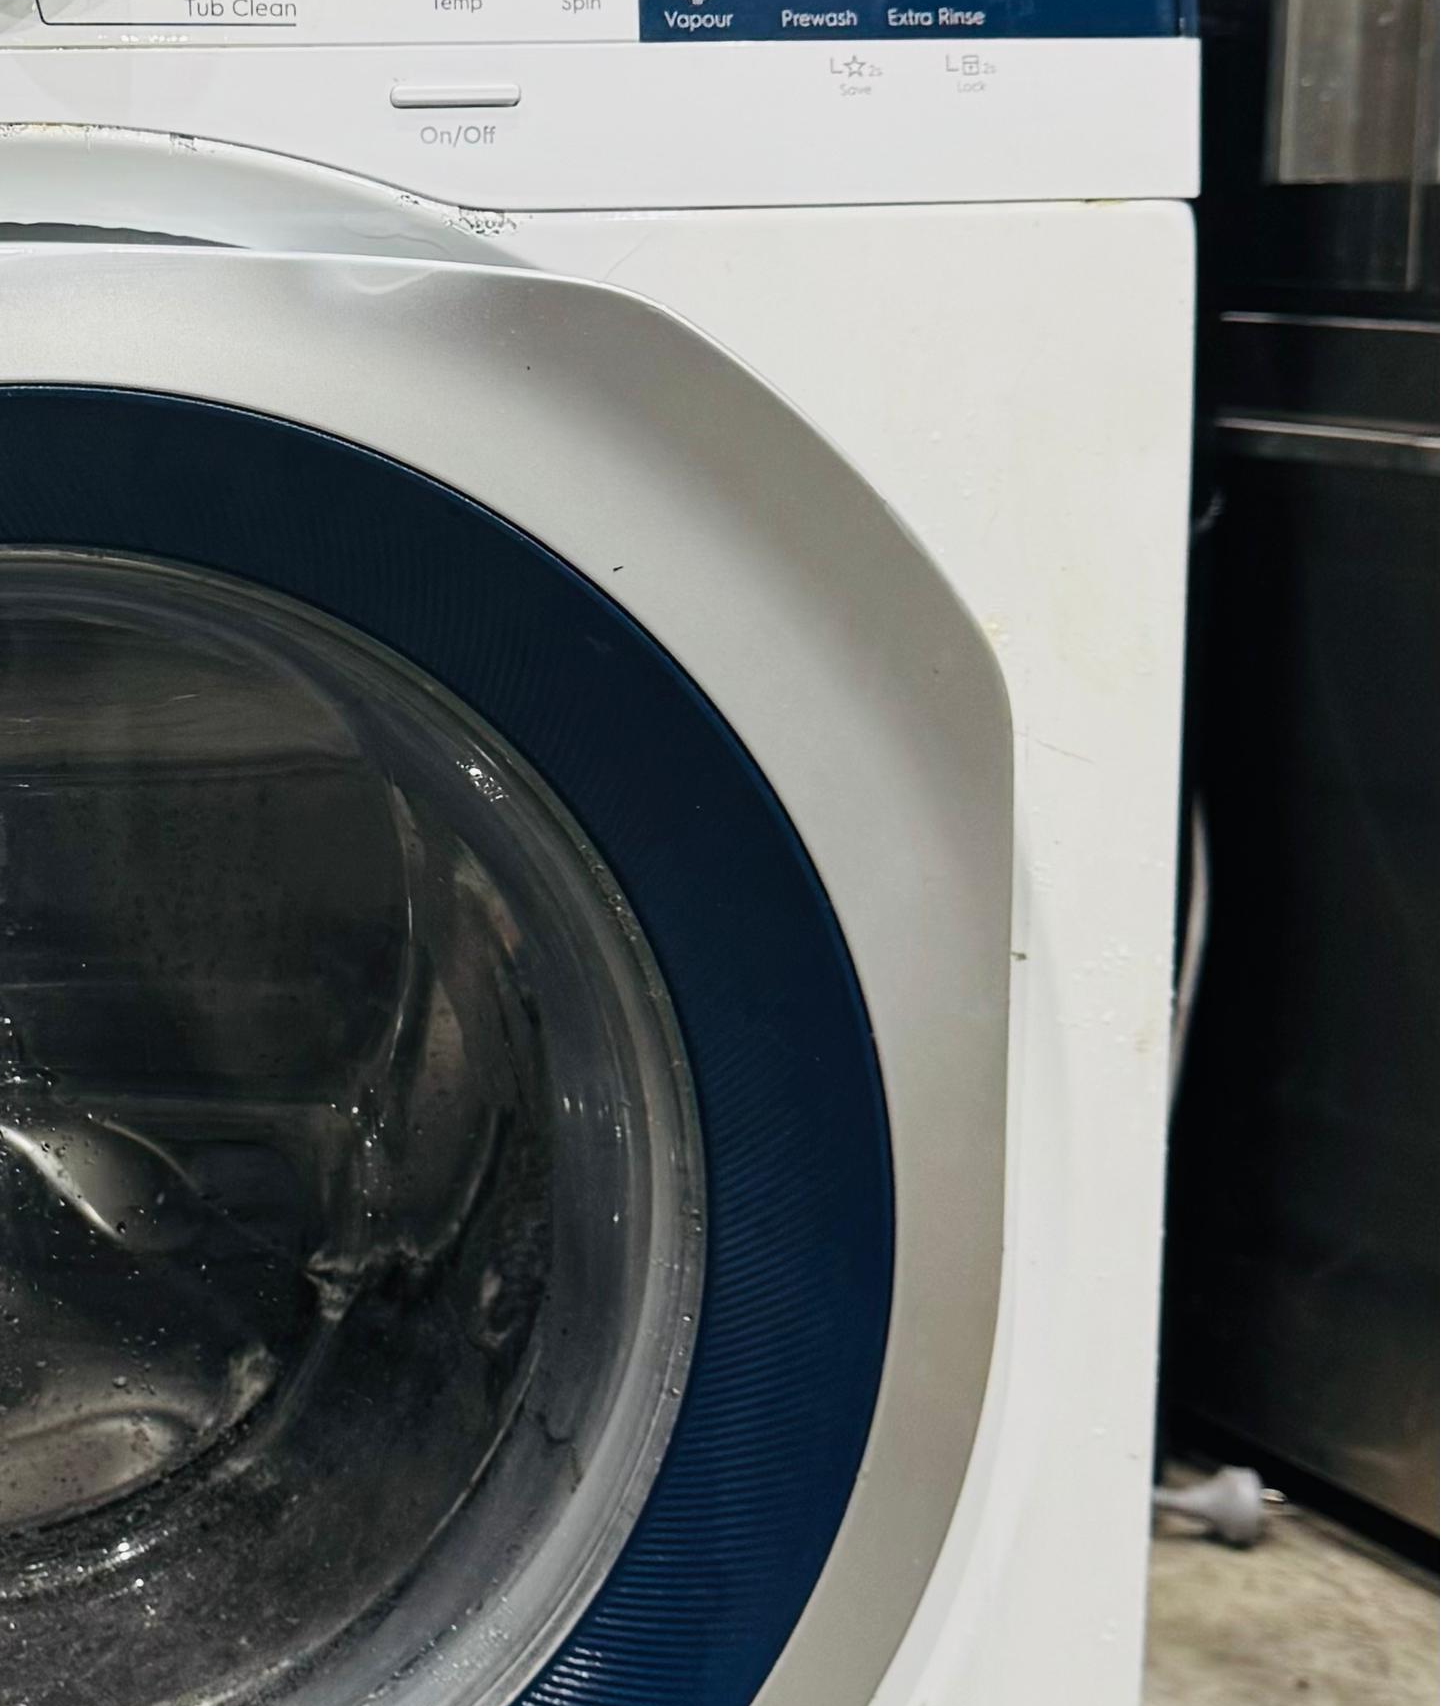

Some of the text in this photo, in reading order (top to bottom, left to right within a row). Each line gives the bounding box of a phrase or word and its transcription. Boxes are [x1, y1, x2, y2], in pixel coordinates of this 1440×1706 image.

[664, 10, 733, 32] Vapour
[782, 9, 858, 28] Prewash
[887, 7, 986, 27] Extra Rinse
[420, 125, 496, 147] On/Off
